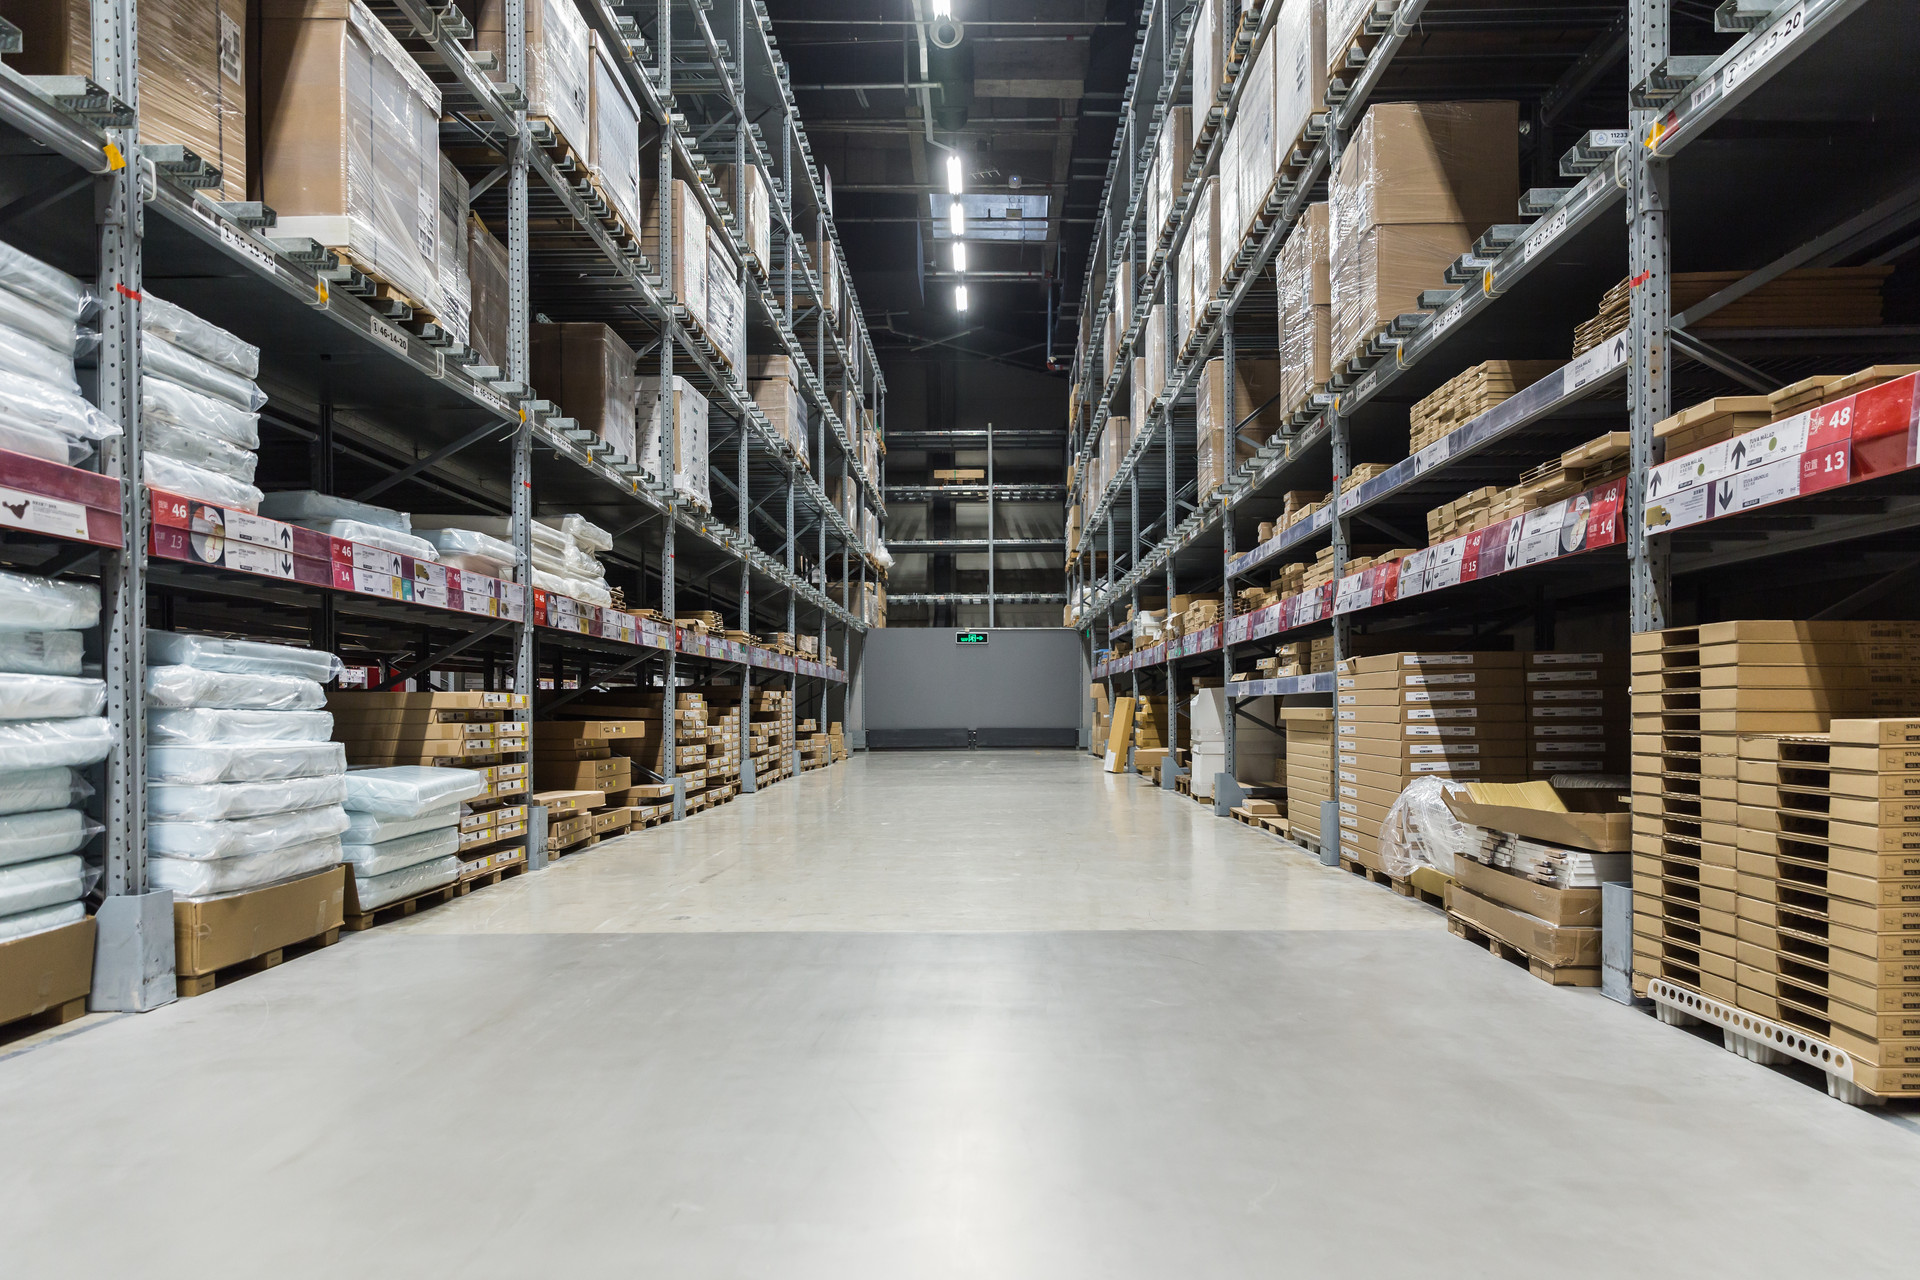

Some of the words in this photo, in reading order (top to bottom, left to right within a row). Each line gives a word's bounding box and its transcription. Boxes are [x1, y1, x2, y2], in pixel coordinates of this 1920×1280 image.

[380, 327, 406, 350] 46-14-20
[1828, 407, 1850, 428] 48
[1825, 451, 1844, 472] 13
[1604, 488, 1616, 502] 48
[172, 504, 186, 518] 46
[1600, 520, 1612, 534] 14
[170, 534, 182, 549] 13
[342, 545, 352, 557] 46
[1468, 561, 1476, 572] 15
[342, 571, 350, 582] 14
[454, 574, 460, 582] 46
